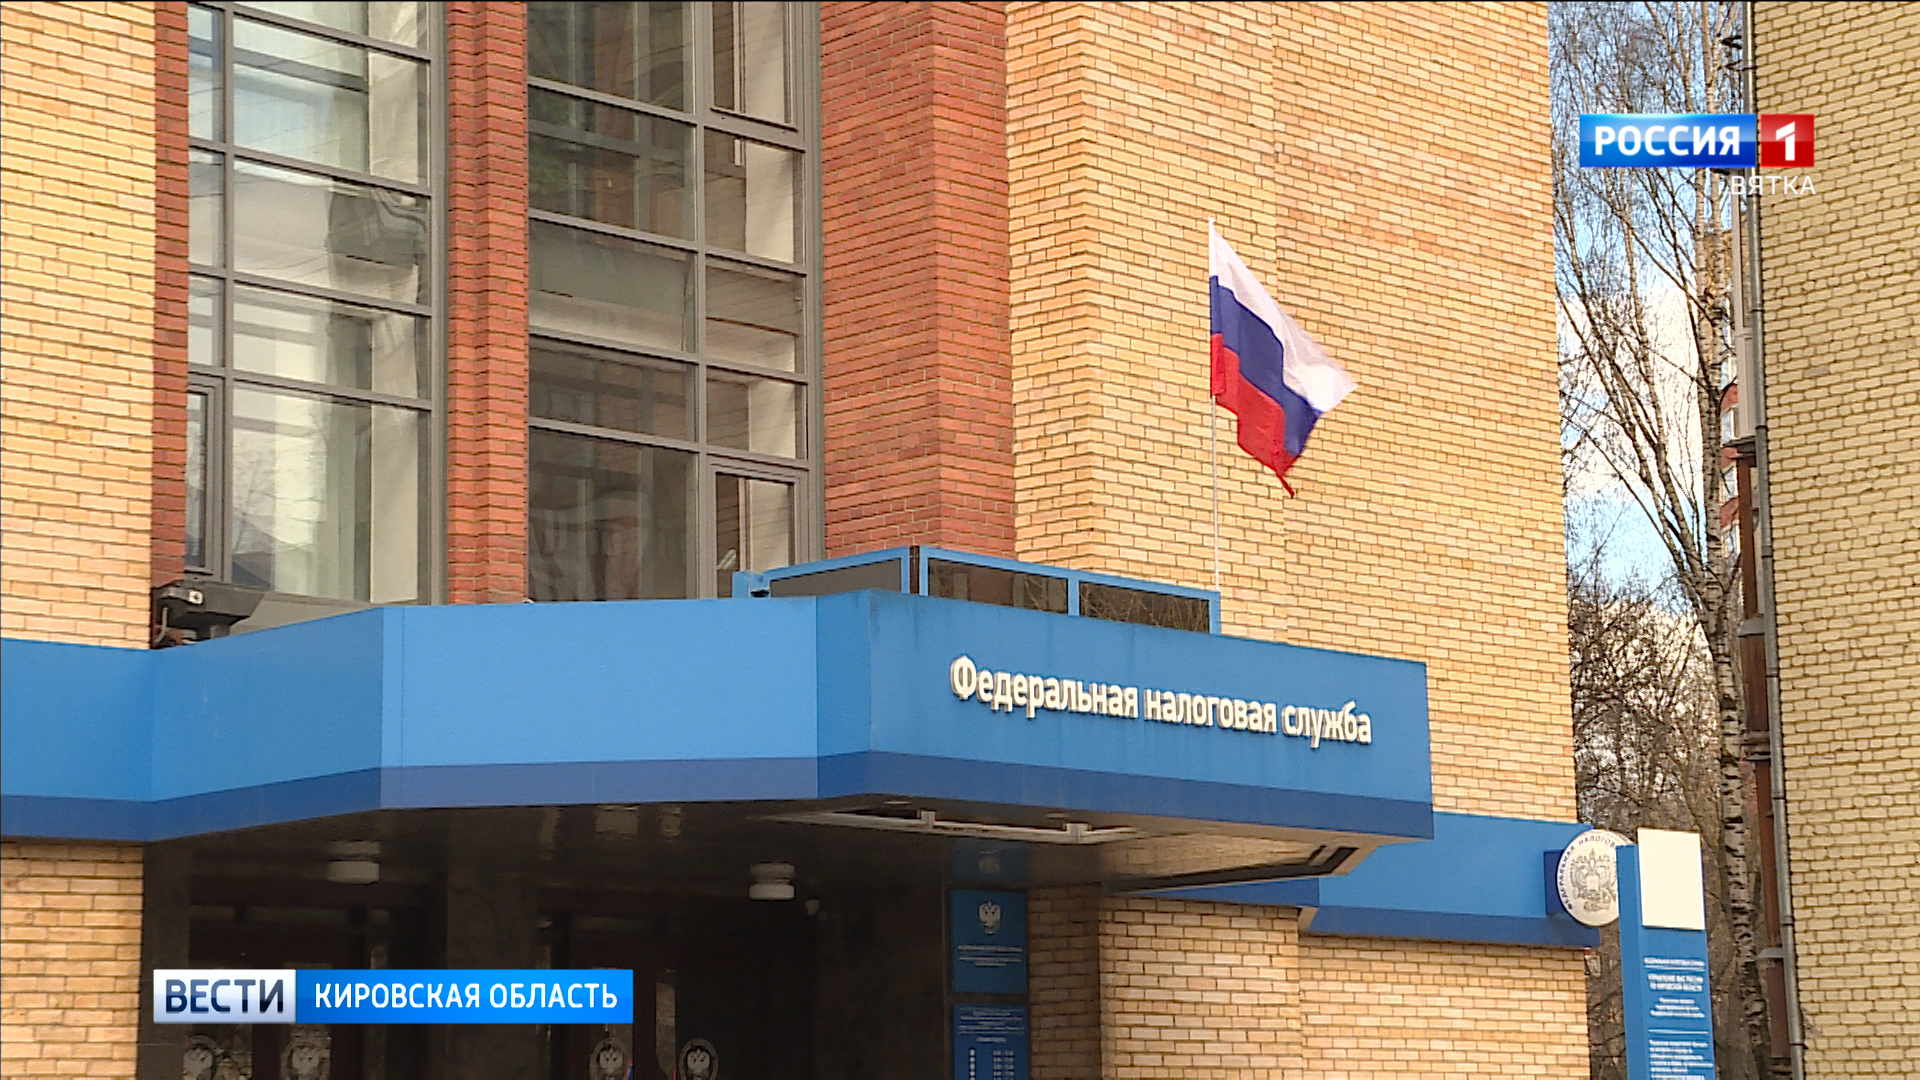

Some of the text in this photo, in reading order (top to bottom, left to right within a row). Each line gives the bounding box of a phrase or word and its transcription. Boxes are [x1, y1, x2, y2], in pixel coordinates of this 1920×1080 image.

[950, 655, 1372, 749] Федеральная налоговая служба
